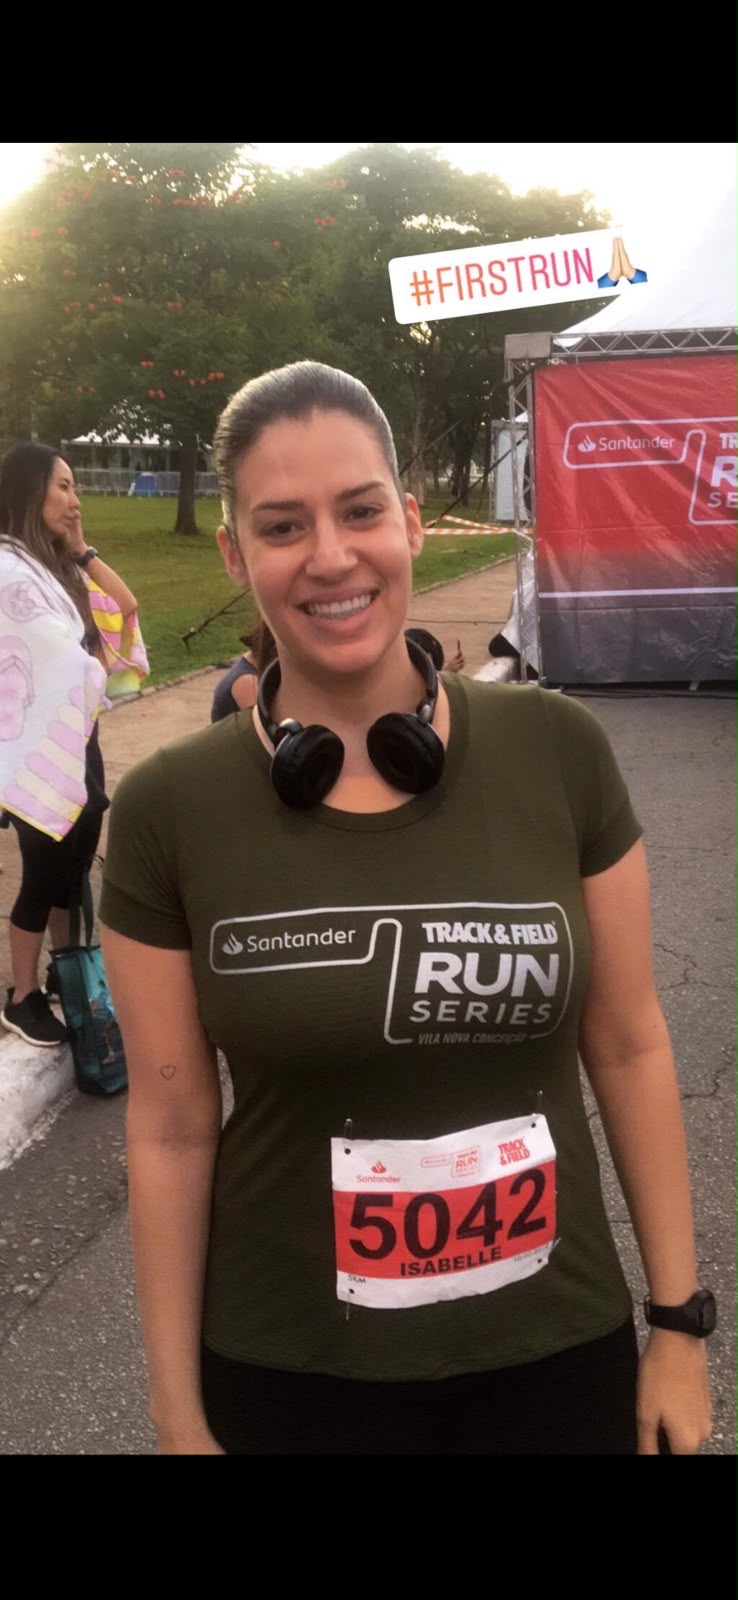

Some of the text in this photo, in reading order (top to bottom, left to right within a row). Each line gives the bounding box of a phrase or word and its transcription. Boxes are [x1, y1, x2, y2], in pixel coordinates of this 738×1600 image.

[598, 435, 675, 452] Santander
[246, 928, 356, 953] Santander
[413, 951, 560, 997] RUN
[409, 1000, 553, 1025] SERIES
[418, 1033, 440, 1045] VILA
[443, 1032, 470, 1044] NOVA
[356, 1174, 401, 1184] Santander
[348, 1168, 547, 1261] 5042
[400, 1246, 502, 1277] ISABELLE
